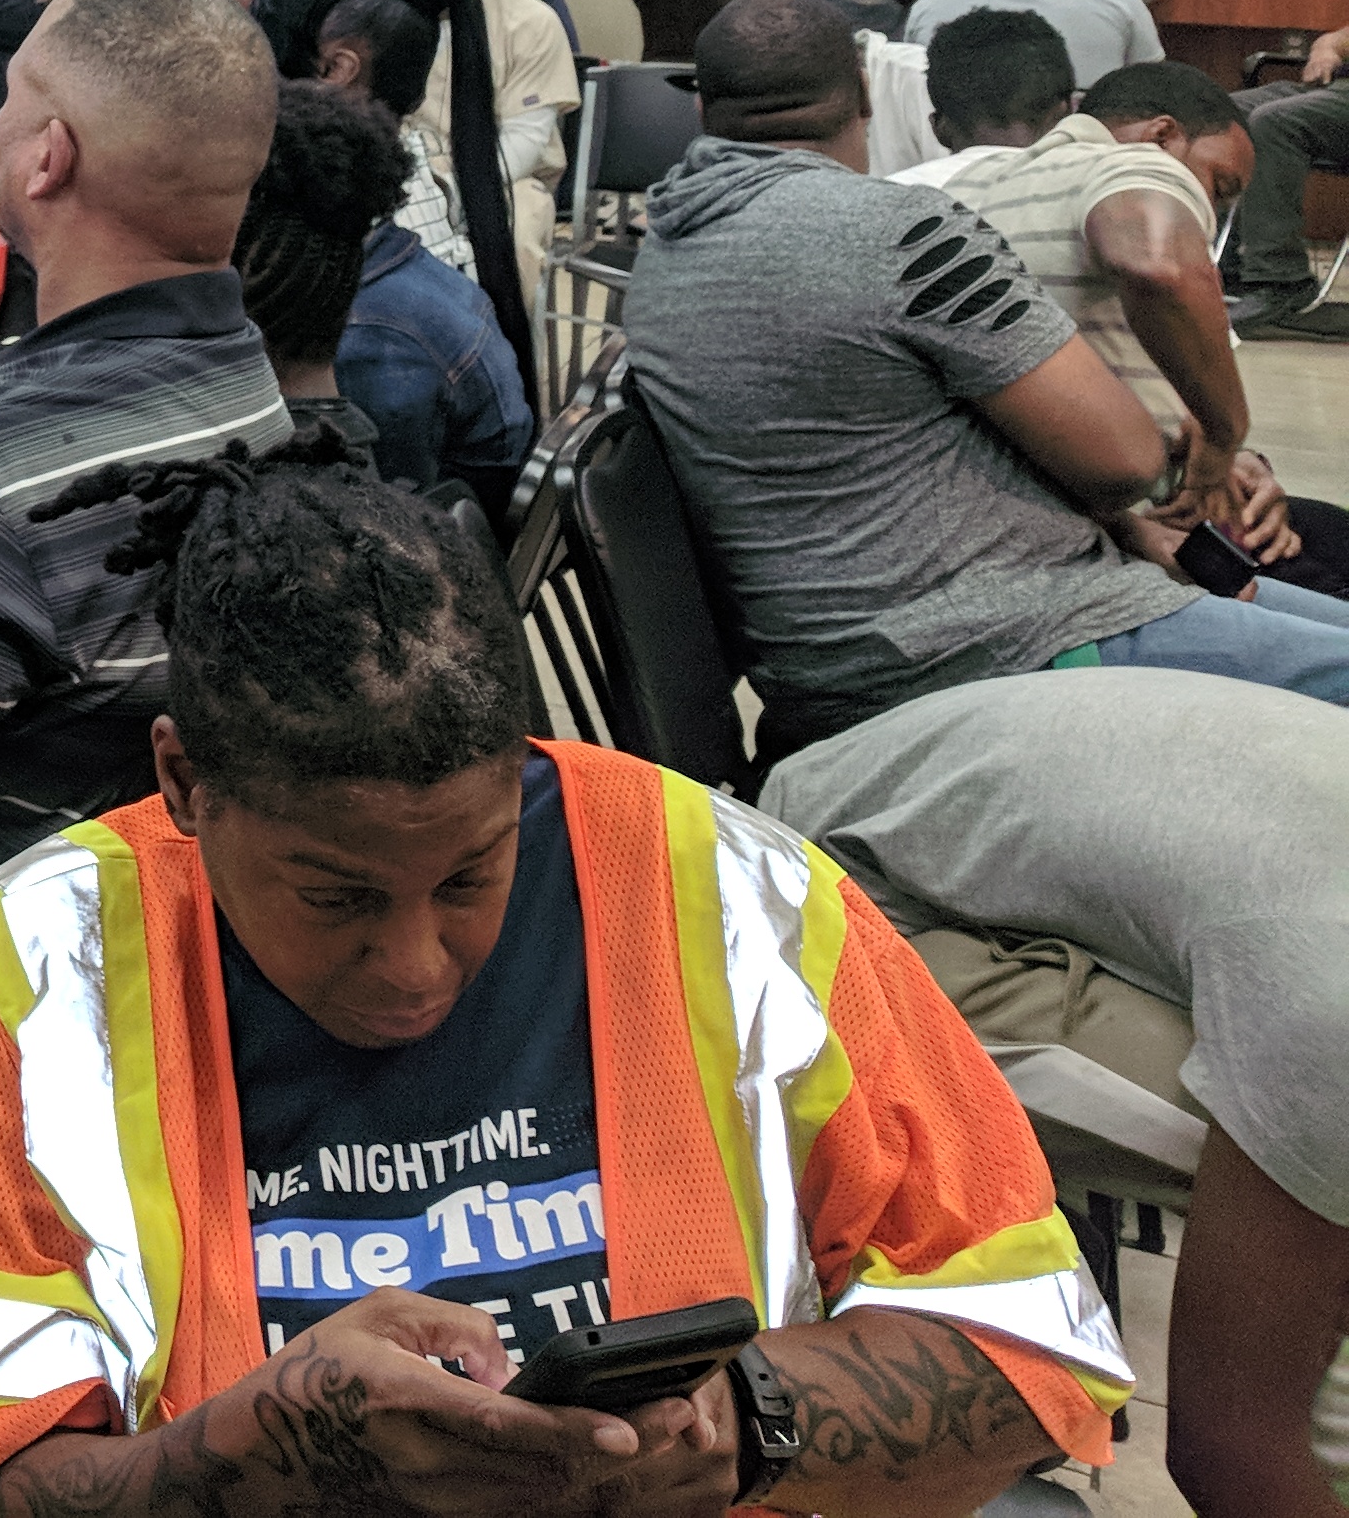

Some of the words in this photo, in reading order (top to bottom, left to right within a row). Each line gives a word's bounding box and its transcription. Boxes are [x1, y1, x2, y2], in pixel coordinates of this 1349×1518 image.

[246, 1165, 310, 1210] ME.
[318, 1107, 551, 1194] NIGHTTIME.
[254, 1229, 412, 1291] me
[426, 1180, 605, 1269] Tim
